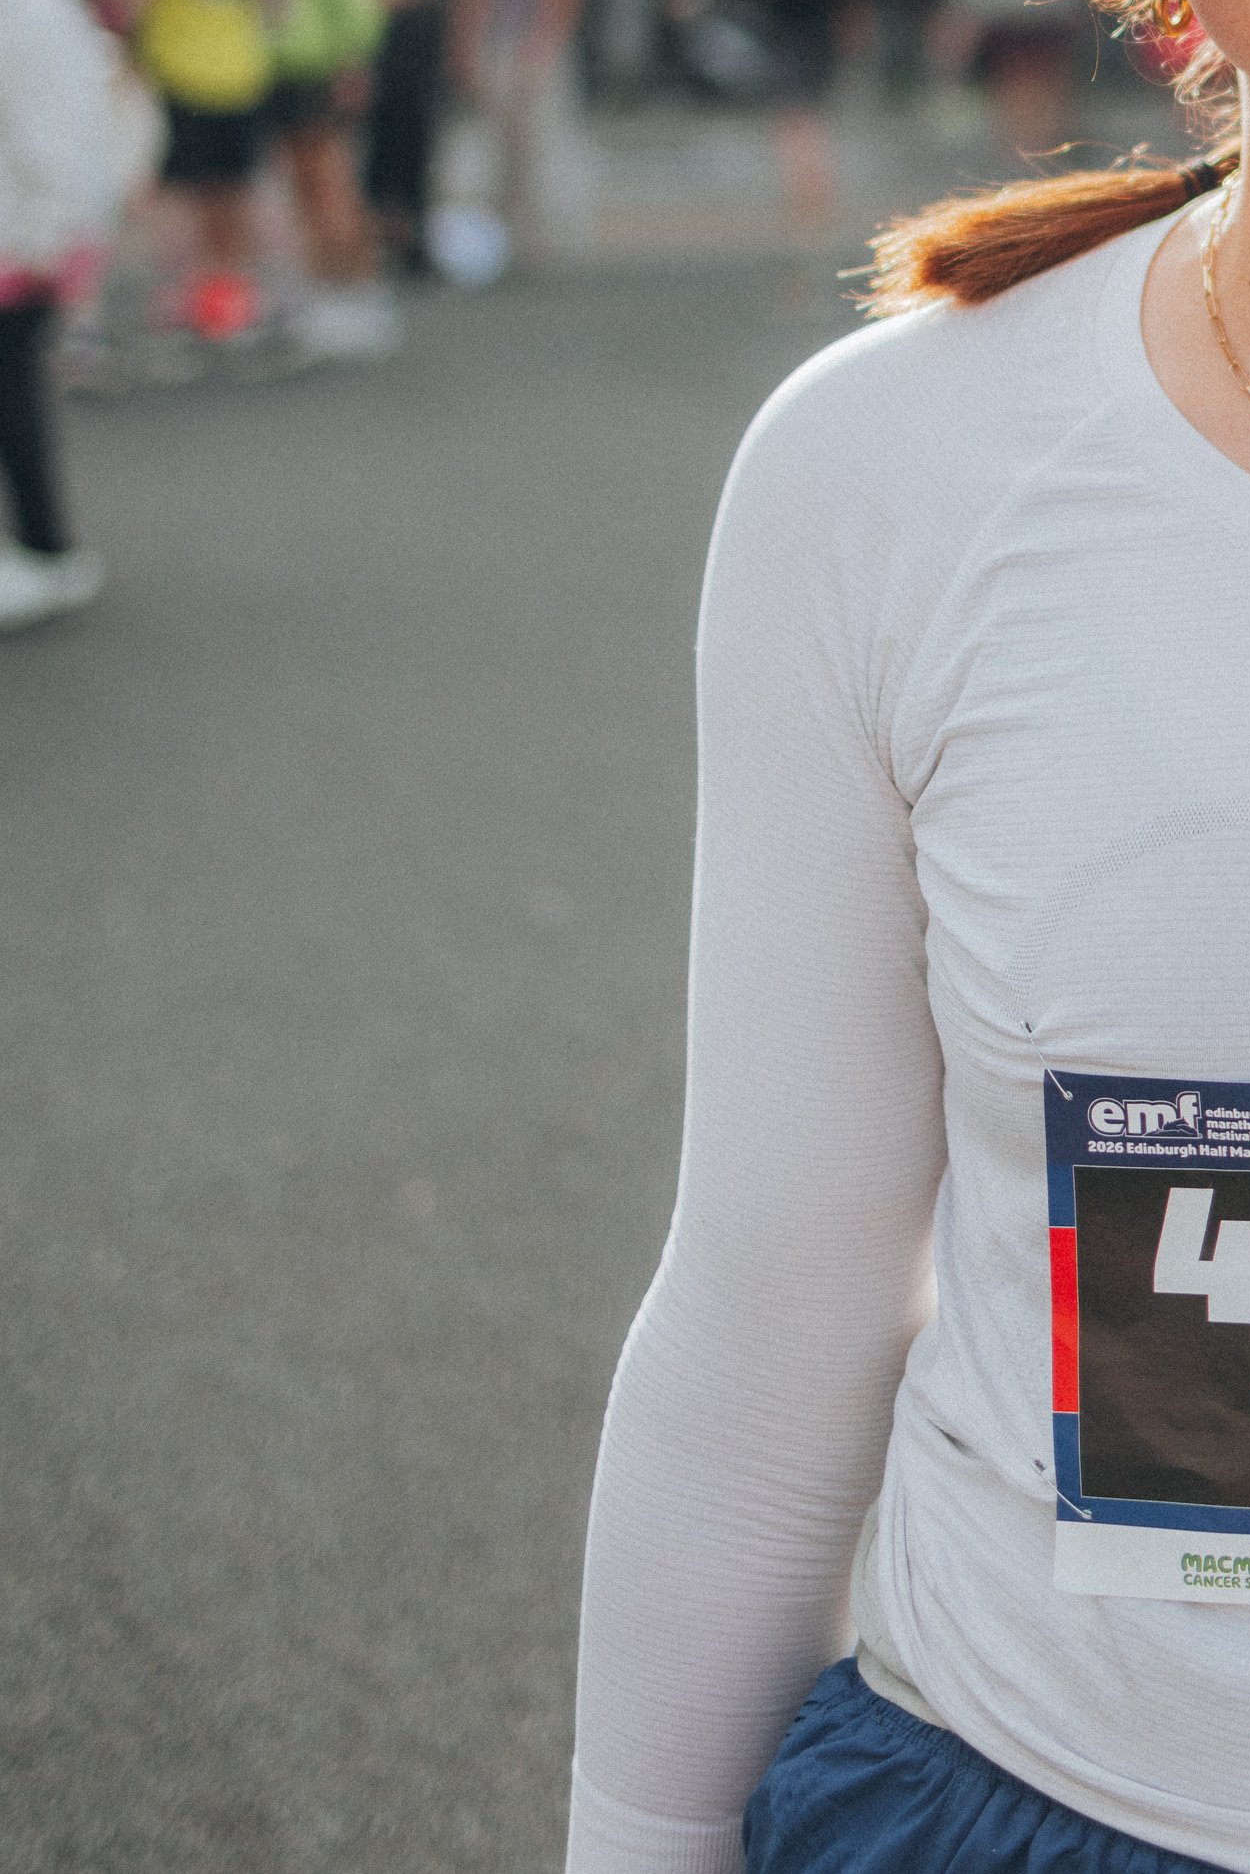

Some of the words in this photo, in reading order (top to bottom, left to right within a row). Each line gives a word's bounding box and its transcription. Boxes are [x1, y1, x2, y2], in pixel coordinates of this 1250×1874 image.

[1087, 1090, 1203, 1139] emf
[1087, 1140, 1125, 1154] 2026
[1126, 1142, 1200, 1158] Edinburgh
[1200, 1144, 1228, 1158] Half
[1183, 1573, 1242, 1589] CANCER
